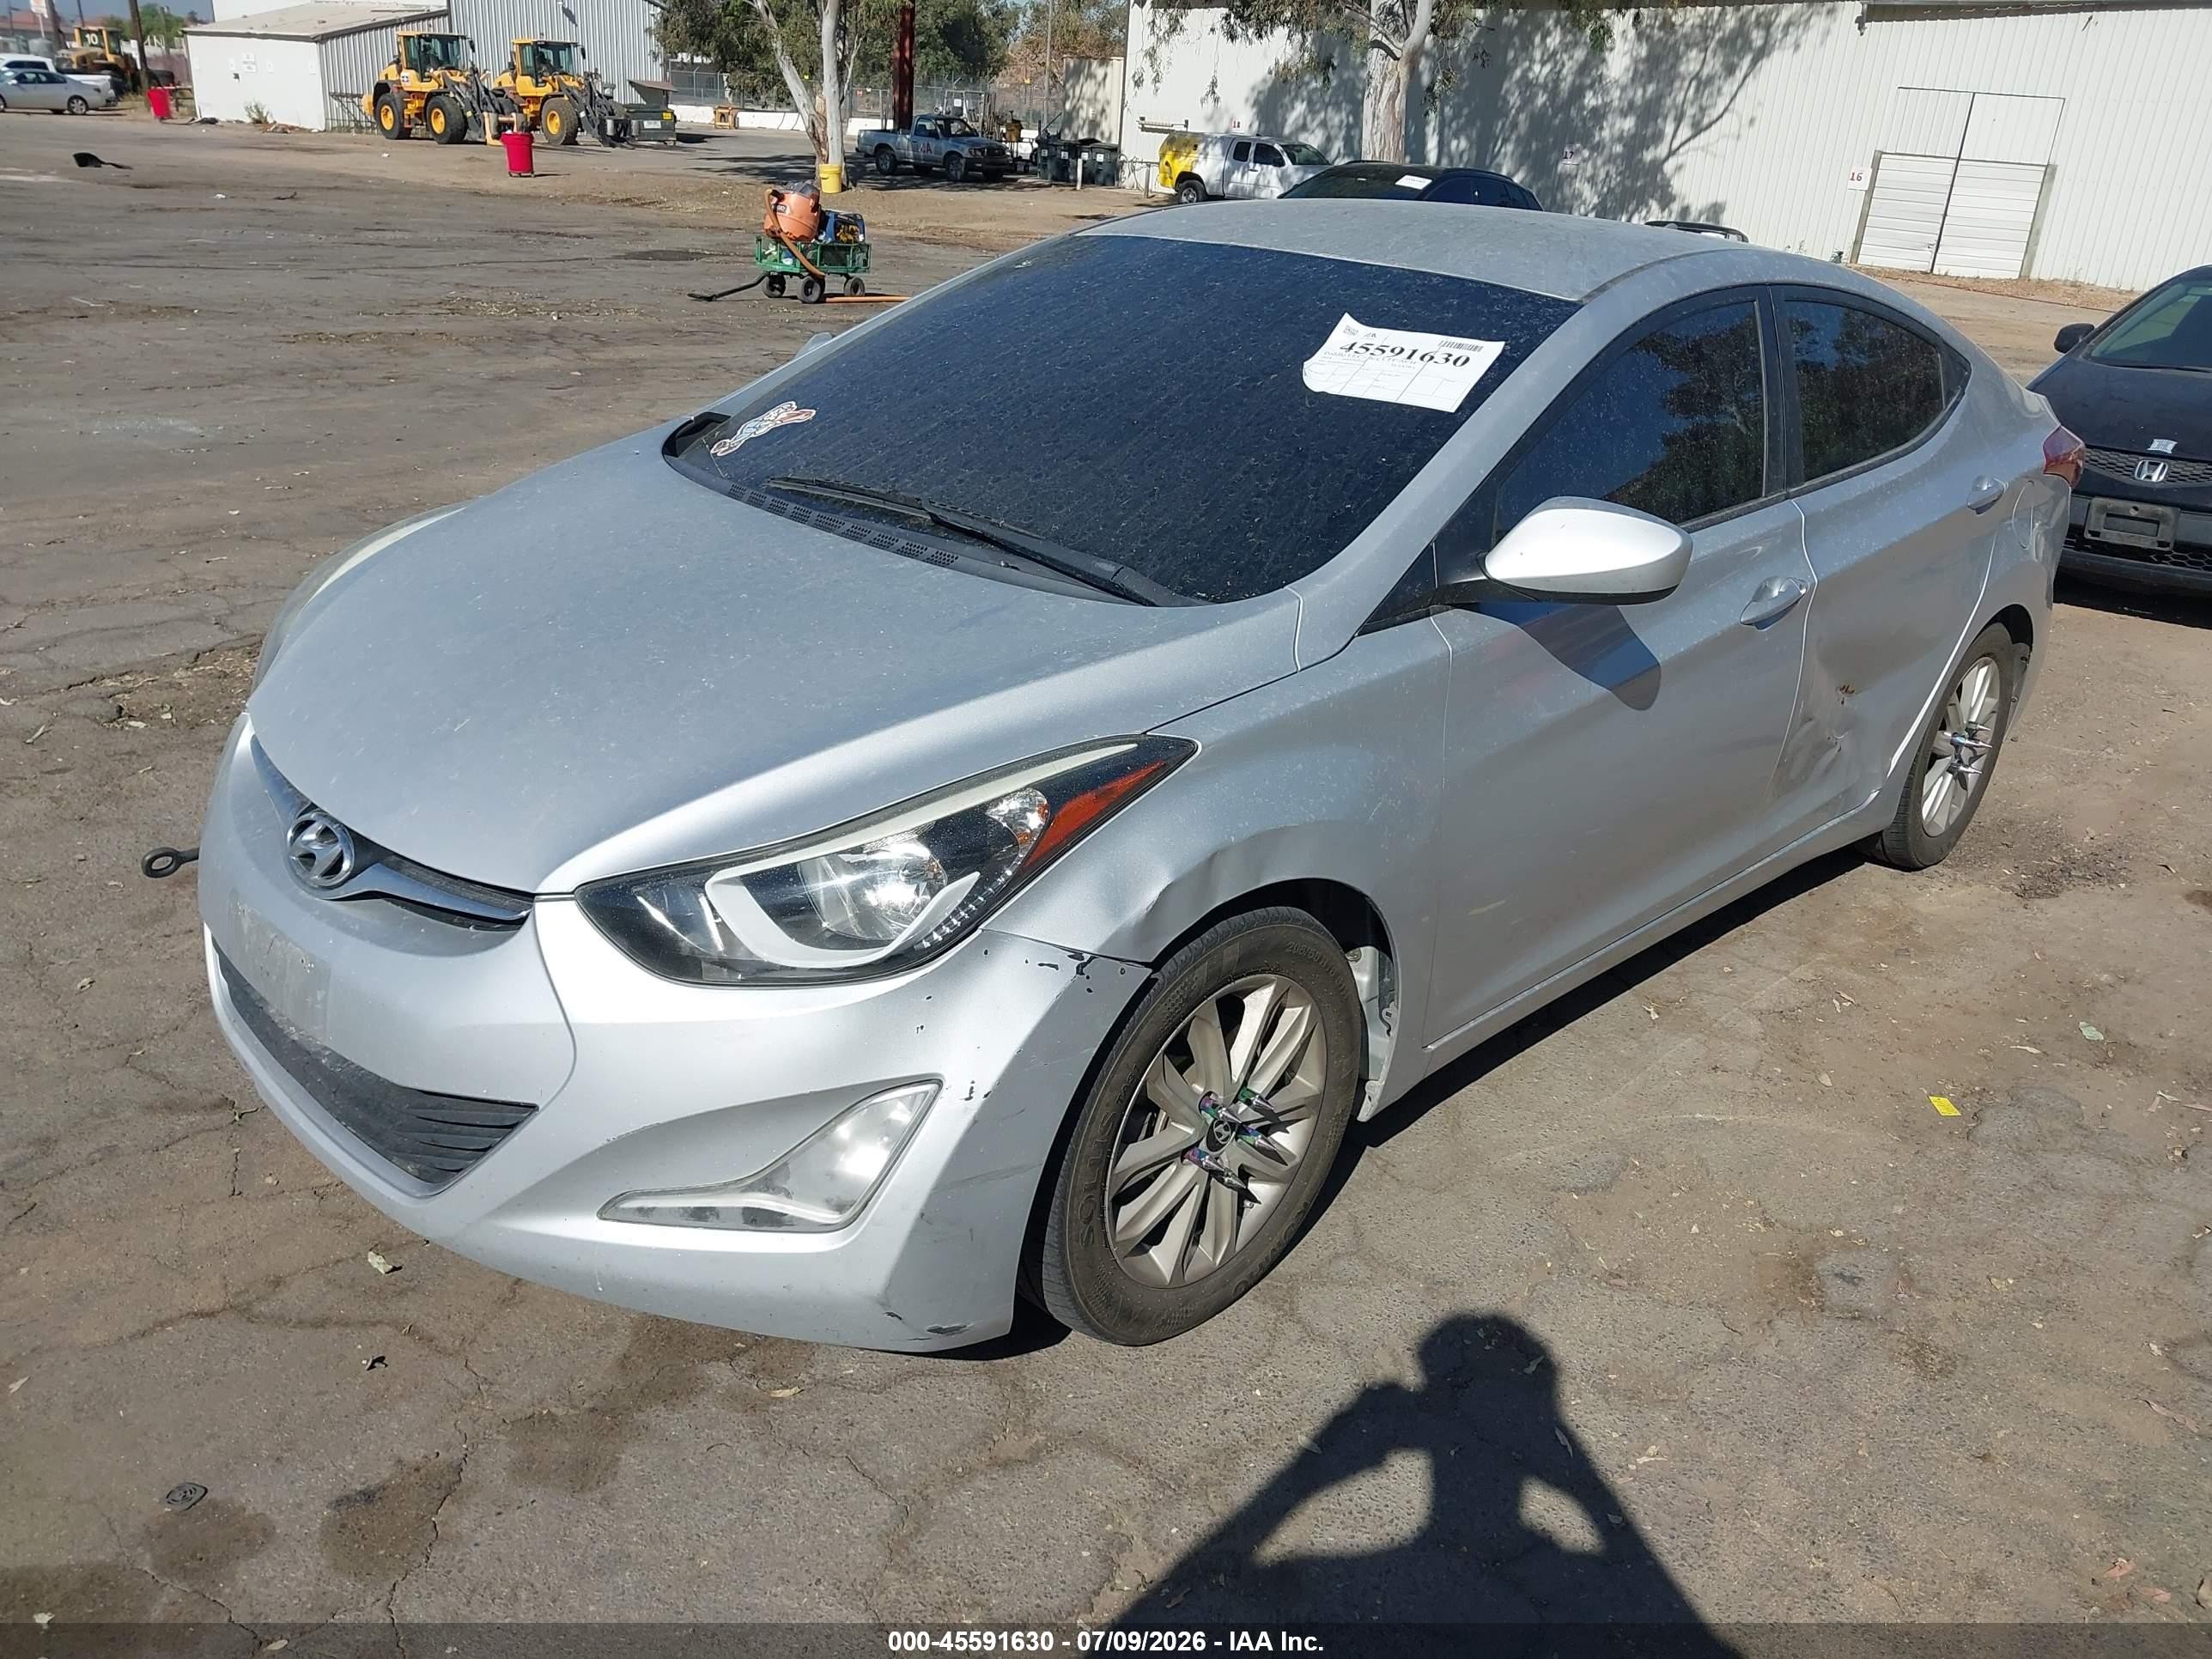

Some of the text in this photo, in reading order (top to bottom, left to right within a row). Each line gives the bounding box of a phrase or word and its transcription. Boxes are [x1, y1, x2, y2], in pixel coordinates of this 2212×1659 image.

[84, 33, 99, 45] 10
[1563, 150, 1574, 160] 17
[1849, 172, 1863, 181] 16
[1339, 341, 1471, 368] 45591630
